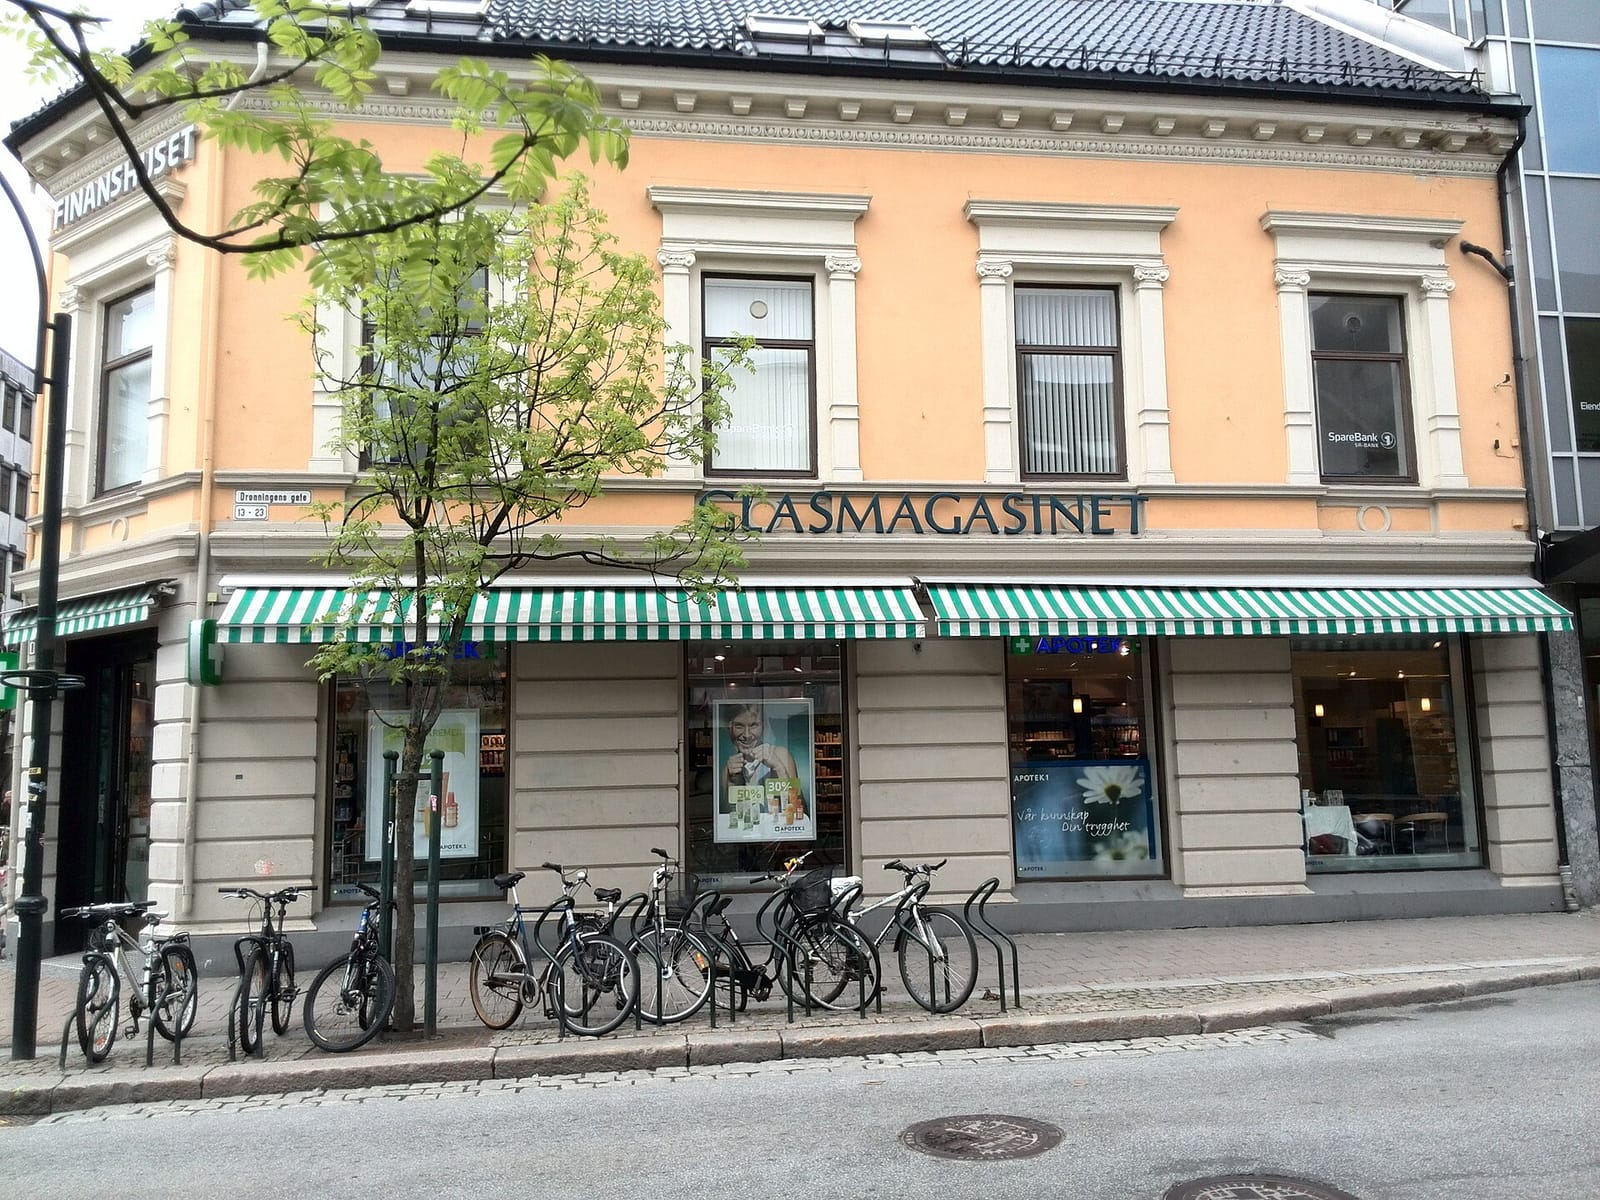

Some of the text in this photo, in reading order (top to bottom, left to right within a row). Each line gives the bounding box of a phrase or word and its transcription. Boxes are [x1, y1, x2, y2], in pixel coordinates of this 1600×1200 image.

[53, 124, 195, 230] FINANSHUSET
[1328, 432, 1378, 443] SpareBank
[290, 493, 307, 504] gate
[237, 508, 246, 517] 13
[255, 508, 265, 517] 23
[698, 489, 1149, 535] GLASMAGASINET
[768, 781, 792, 792] 30%
[737, 789, 762, 799] 50%
[1085, 817, 1131, 836] trygghet
